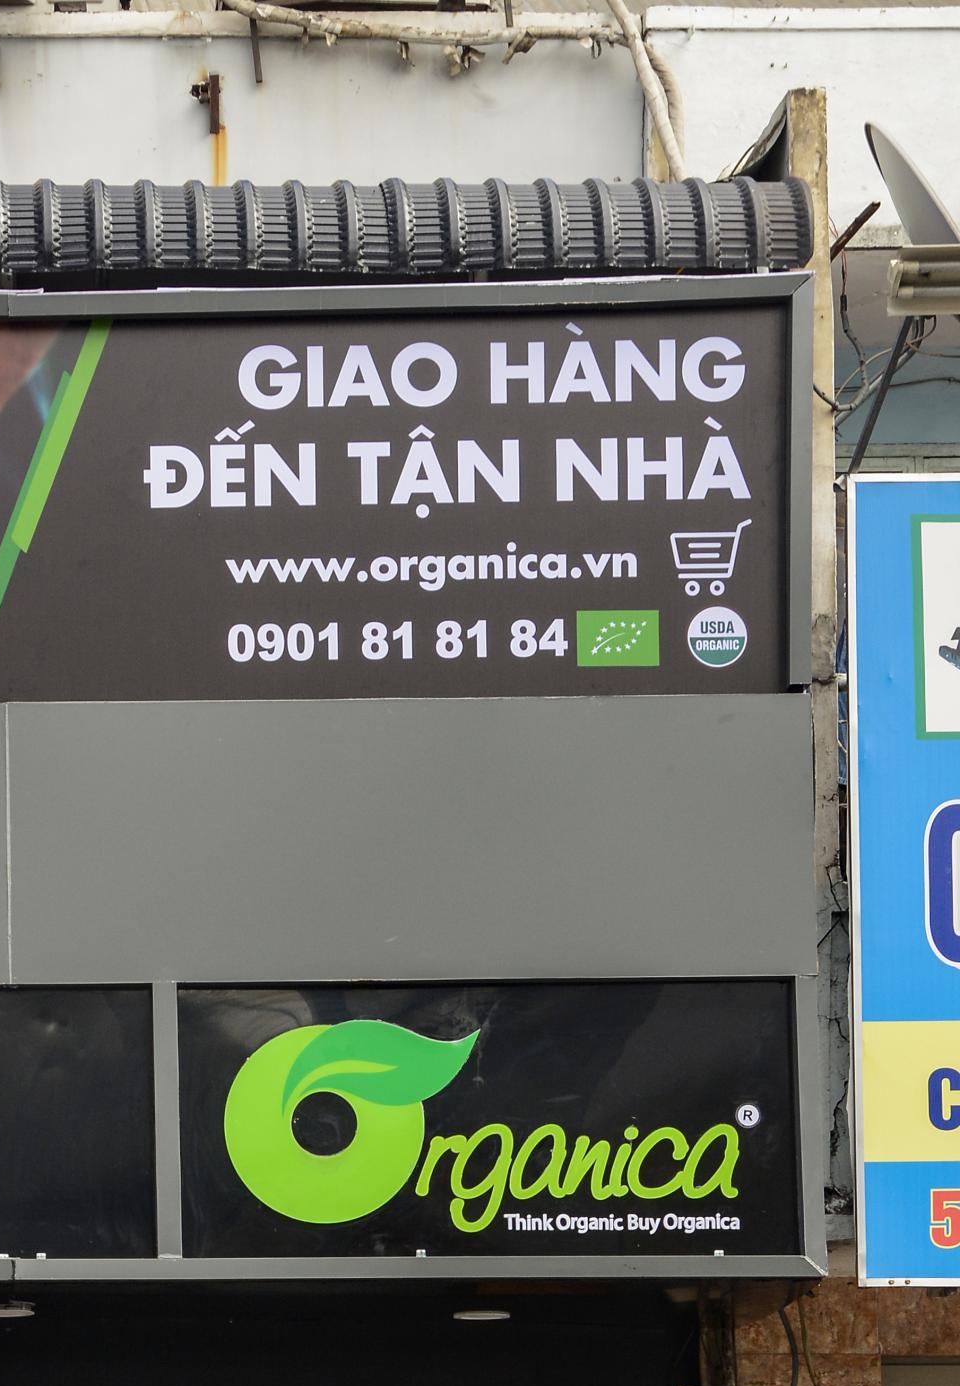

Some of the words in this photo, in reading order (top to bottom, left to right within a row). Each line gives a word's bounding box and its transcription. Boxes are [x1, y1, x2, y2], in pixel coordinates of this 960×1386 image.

[238, 342, 458, 410] GIAO
[490, 321, 746, 405] HÀNG
[144, 420, 316, 510] ĐẾN
[348, 424, 521, 519] TẬN
[556, 416, 752, 503] NHÀ
[226, 542, 638, 592] www.organica.vn
[227, 622, 340, 663] 0901
[361, 620, 414, 661] 81
[435, 619, 488, 659] 81
[509, 618, 569, 658] 84
[695, 639, 740, 651] ORGANIC
[700, 620, 735, 634] USDA
[224, 1020, 739, 1233] Organica
[504, 1213, 554, 1232] Think
[555, 1213, 624, 1234] Organic
[627, 1213, 661, 1235] Buy
[663, 1212, 740, 1234] Organica
